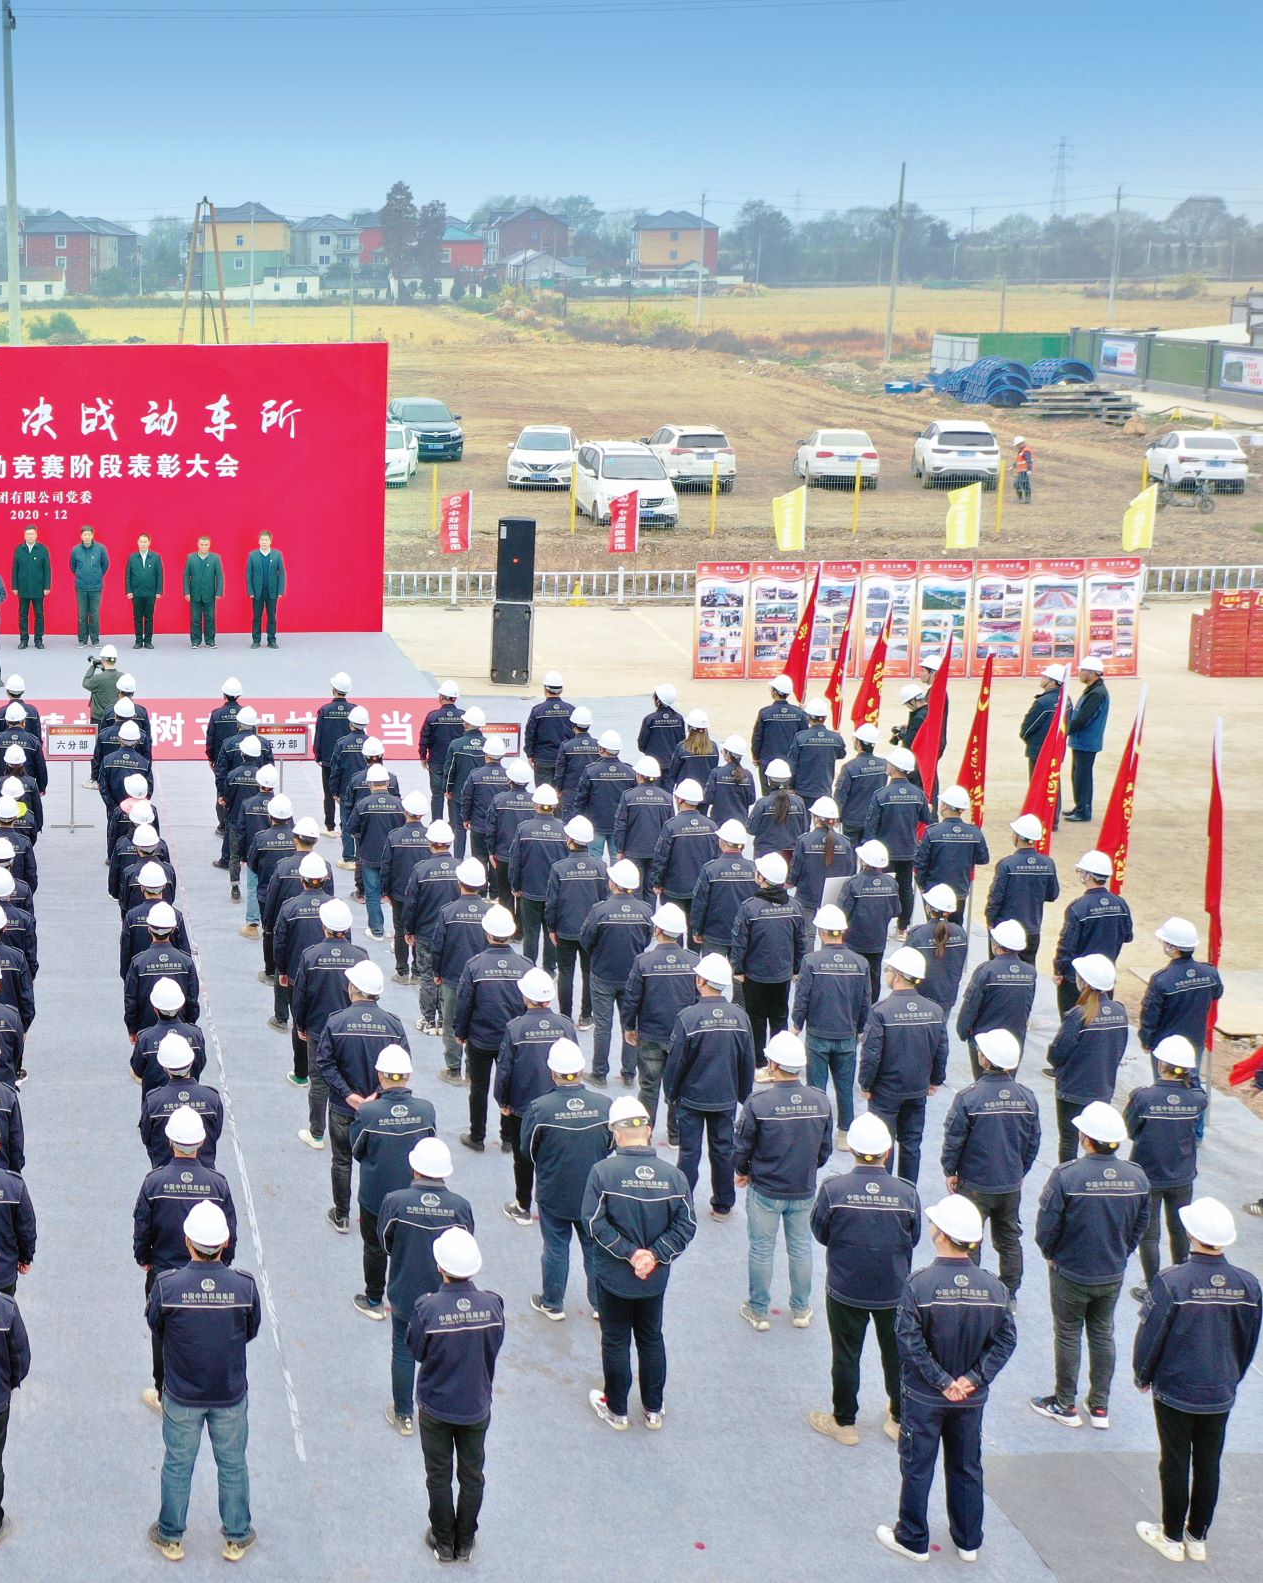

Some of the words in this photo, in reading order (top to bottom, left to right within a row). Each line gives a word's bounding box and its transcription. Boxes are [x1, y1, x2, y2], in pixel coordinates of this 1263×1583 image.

[21, 394, 302, 442] 决战动车所
[56, 740, 89, 750] 六分部
